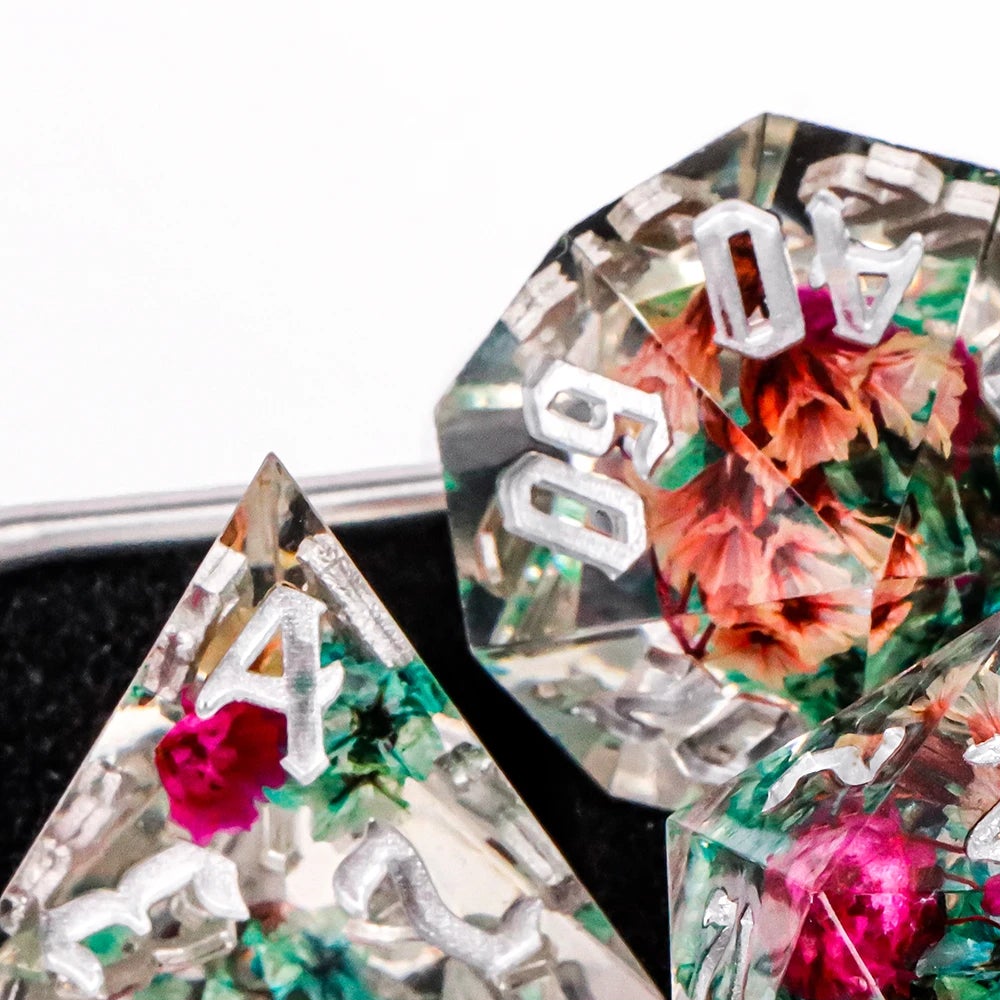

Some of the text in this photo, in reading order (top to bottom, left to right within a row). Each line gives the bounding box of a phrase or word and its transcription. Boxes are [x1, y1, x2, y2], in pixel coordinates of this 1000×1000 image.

[196, 581, 345, 785] 4
[40, 844, 249, 998] 3
[333, 818, 543, 987] 2
